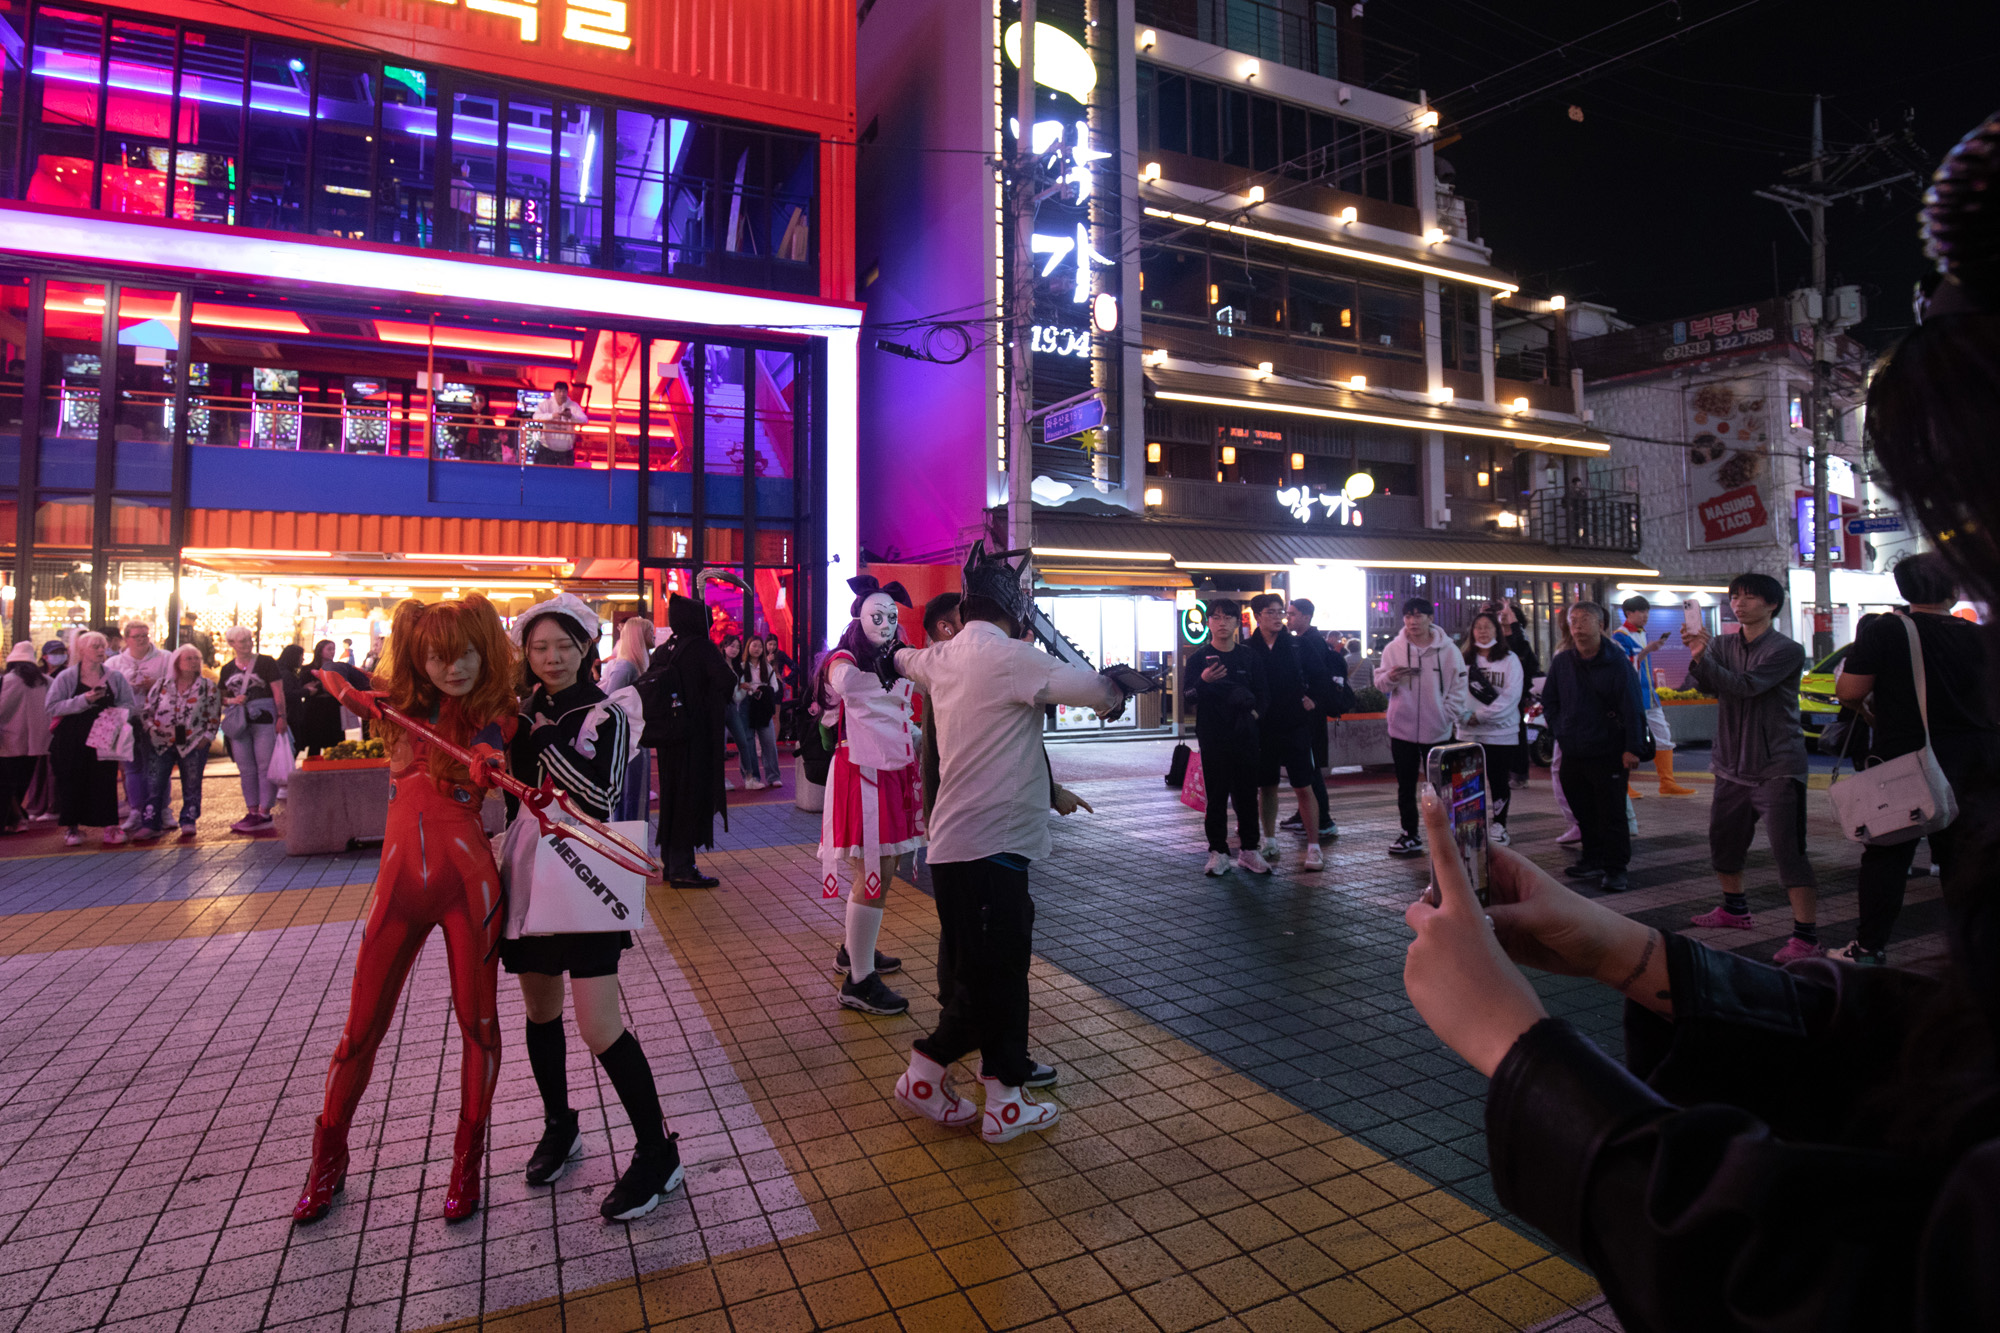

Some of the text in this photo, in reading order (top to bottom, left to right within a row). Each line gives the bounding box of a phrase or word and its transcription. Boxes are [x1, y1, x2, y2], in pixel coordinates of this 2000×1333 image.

[1689, 307, 1759, 340] 부동산
[1704, 494, 1756, 521] NASUNG
[1716, 511, 1752, 532] TACO
[548, 836, 630, 921] HEIGHTS
